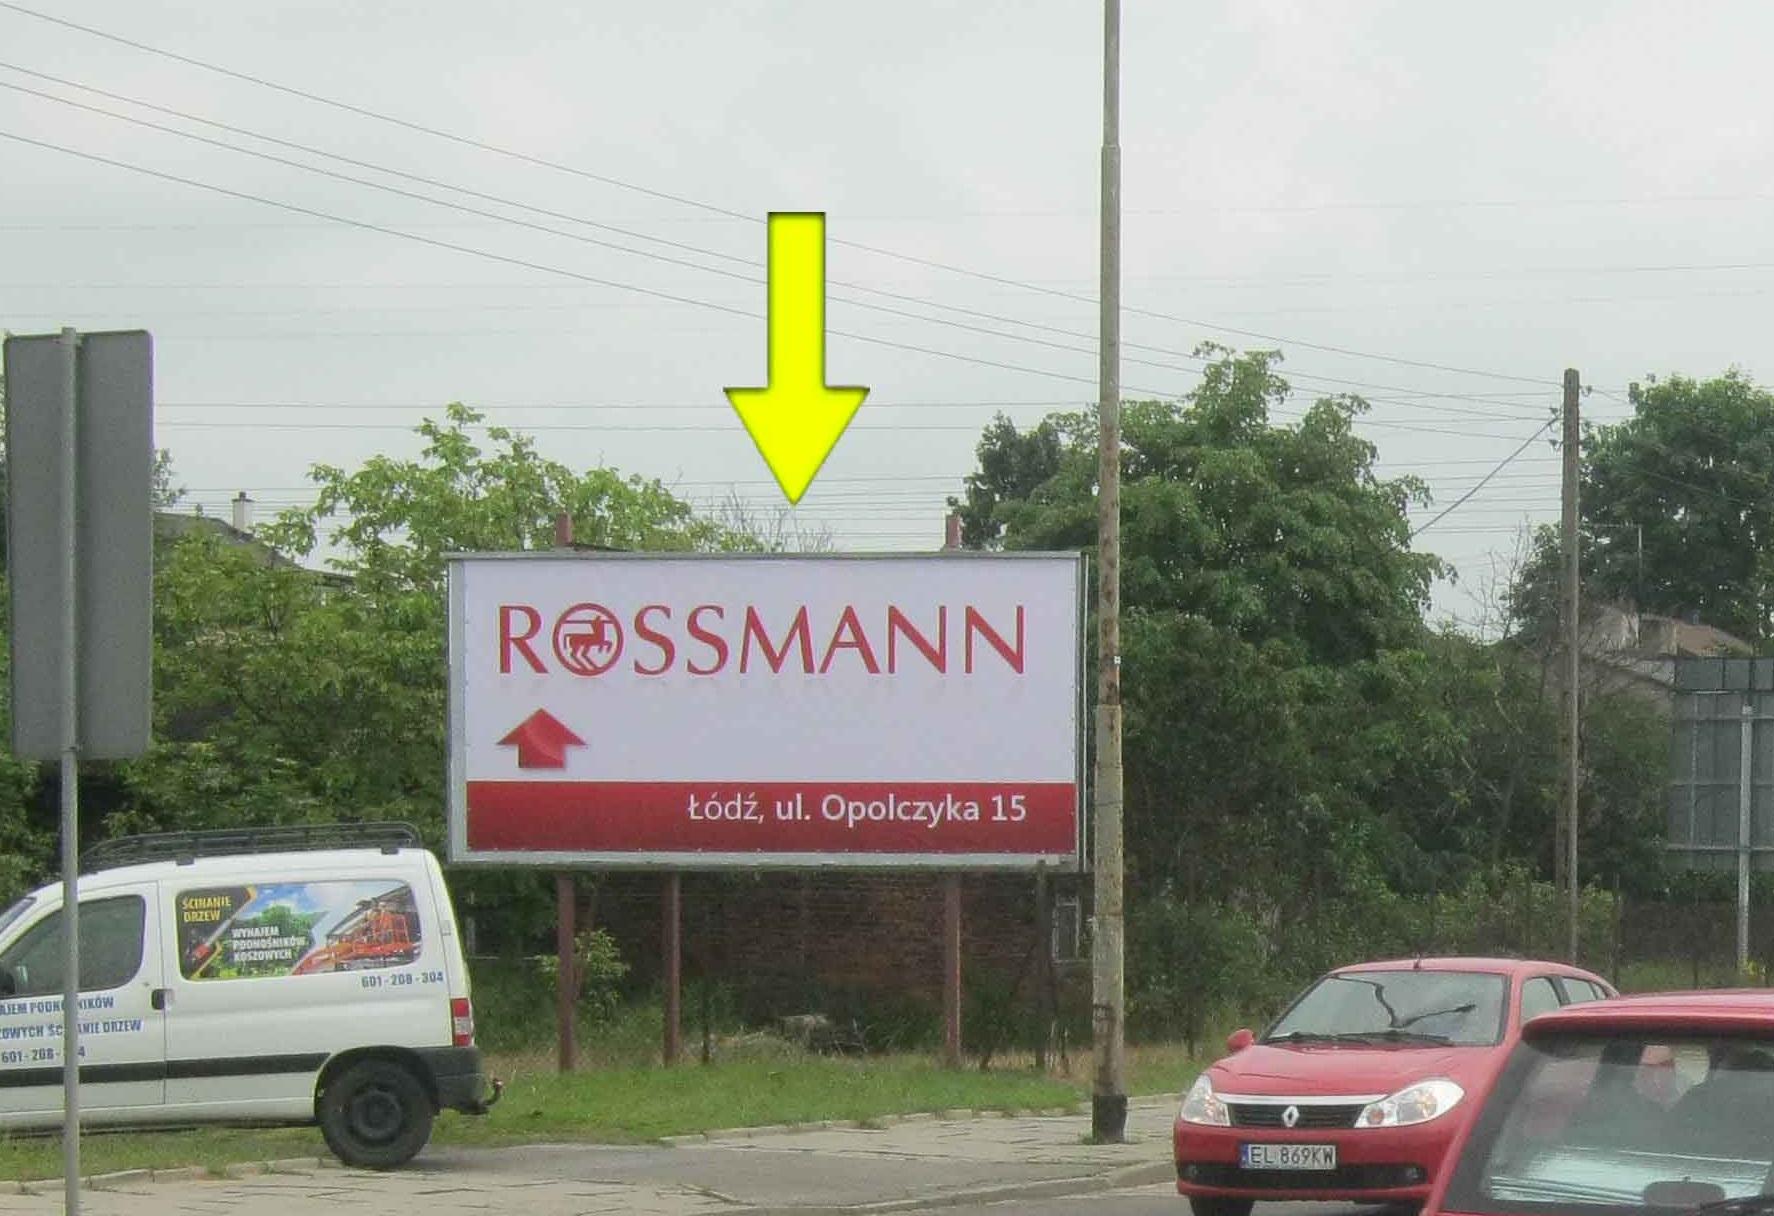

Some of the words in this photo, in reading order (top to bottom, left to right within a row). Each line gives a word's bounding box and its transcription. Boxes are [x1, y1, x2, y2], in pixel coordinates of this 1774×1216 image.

[499, 603, 1025, 676] ROSSMANN
[688, 791, 765, 825] Łódź,
[776, 793, 811, 821] ul.
[822, 793, 980, 828] Opolczyka
[991, 795, 1027, 821] 15
[183, 910, 220, 922] DRZEW
[103, 1019, 142, 1033] DRZEW
[1251, 1146, 1275, 1164] EL
[1280, 1146, 1333, 1165] 869KW
